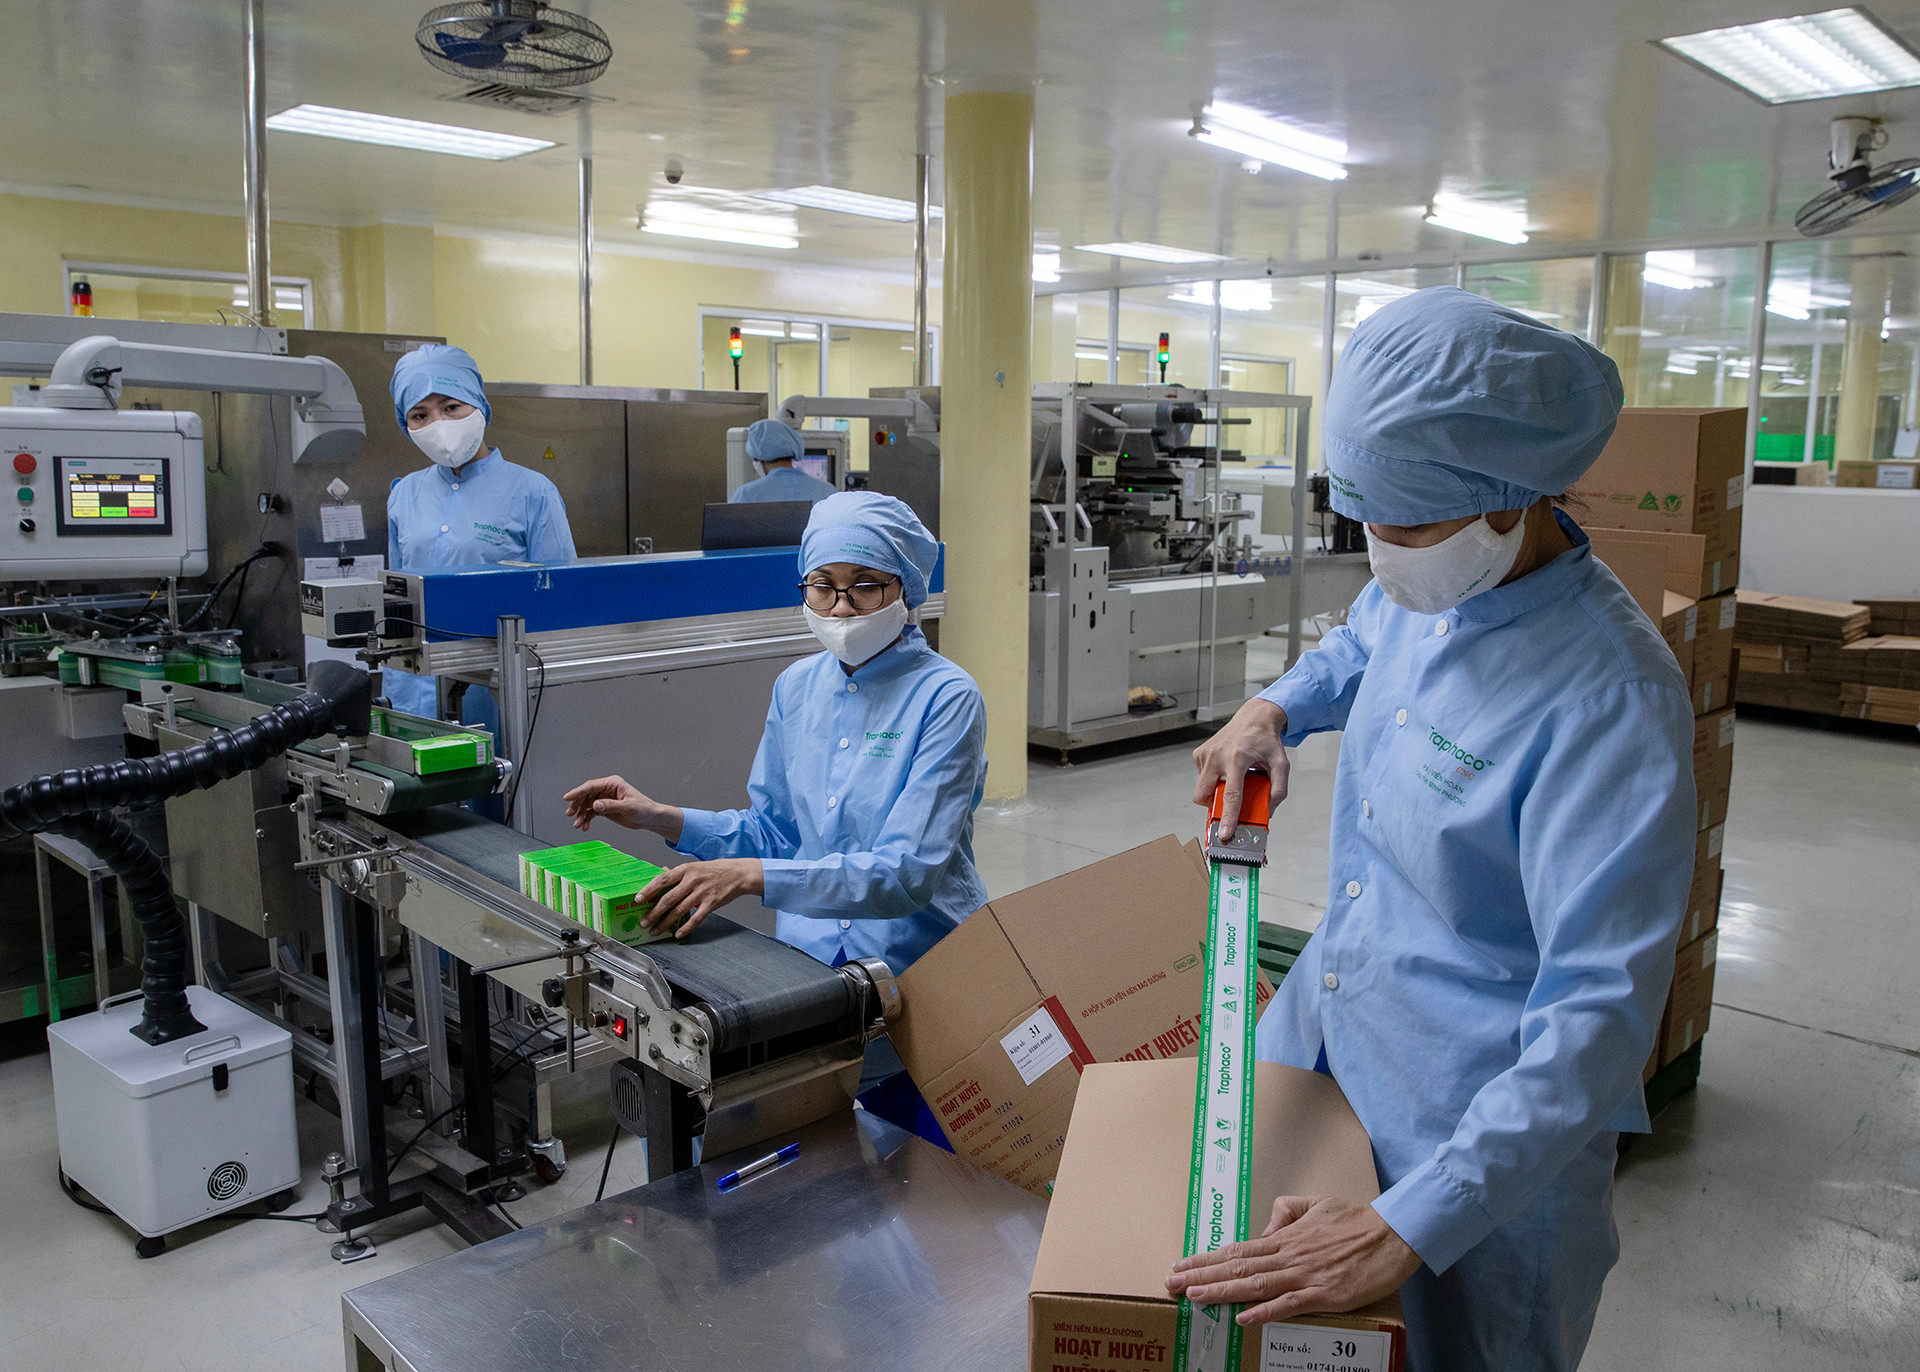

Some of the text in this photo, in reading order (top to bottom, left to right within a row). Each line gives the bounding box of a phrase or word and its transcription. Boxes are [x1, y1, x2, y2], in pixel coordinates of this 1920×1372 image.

[1224, 925, 1238, 966] Traphaco
[1028, 1024, 1041, 1039] 31
[1152, 1015, 1200, 1059] HUYẾT
[1217, 1046, 1233, 1095] Traphaco
[939, 1079, 982, 1117] HOẠT HUYẾT
[994, 1100, 1014, 1116] 17224
[948, 1097, 992, 1133] DƯỠNG NÃO
[1001, 1114, 1024, 1133] 111024
[1009, 1133, 1033, 1152] 111027
[1207, 1193, 1225, 1252] Traphaco
[1053, 1322, 1073, 1332] VIÊN
[1093, 1326, 1111, 1334] BAO
[1112, 1327, 1144, 1337] ĐƯỜNG
[1054, 1336, 1167, 1363] HOẠT HUYẾT
[1270, 1340, 1357, 1358] Kiện số: 30
[1306, 1362, 1370, 1372] 01741-01800
